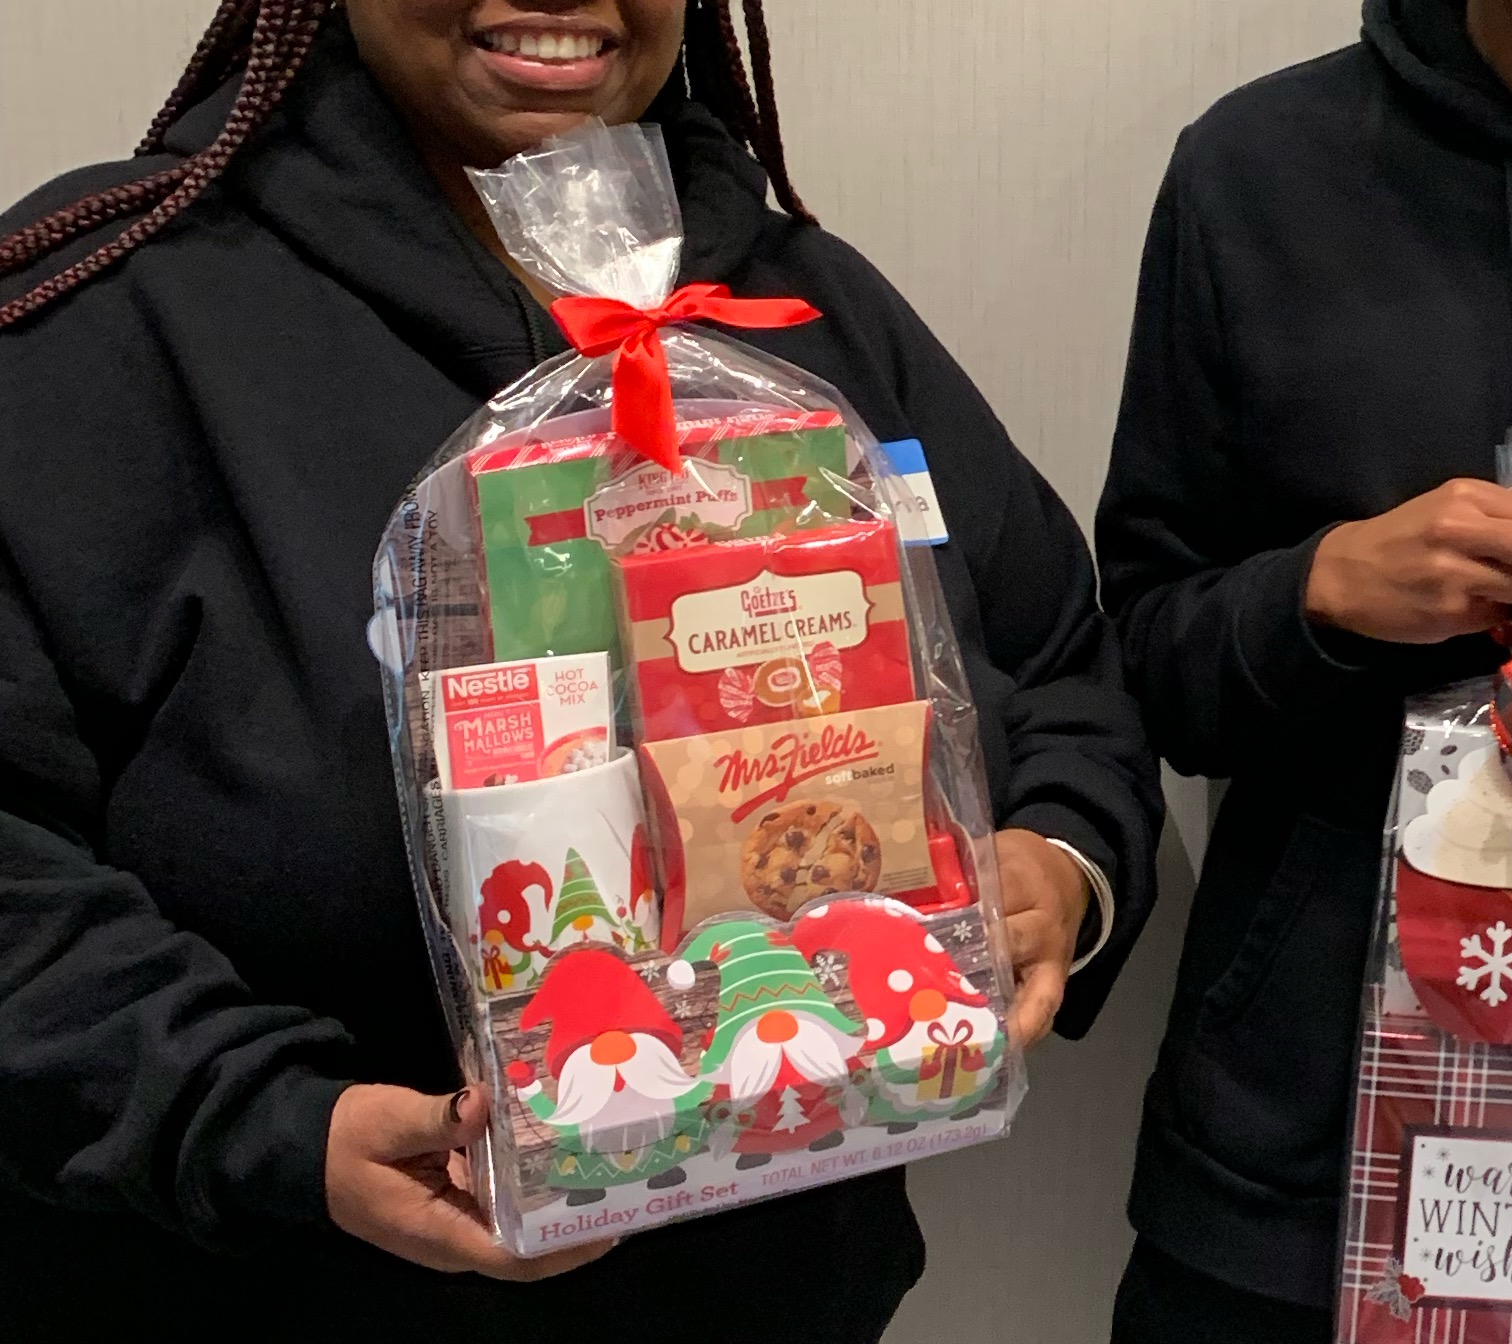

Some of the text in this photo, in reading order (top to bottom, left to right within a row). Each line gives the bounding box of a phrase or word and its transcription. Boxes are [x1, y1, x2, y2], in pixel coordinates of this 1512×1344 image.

[594, 493, 692, 522] Peppermint
[696, 489, 737, 504] Puffs
[688, 621, 780, 654] CARAMEL
[785, 611, 852, 639] CREAMS
[546, 680, 598, 697] COCOA
[554, 668, 584, 681] HOT
[560, 693, 586, 707] MIX
[453, 712, 532, 739] MARSH
[464, 727, 534, 754] MALLOWS
[713, 724, 876, 798] Mrs. Fields
[761, 1166, 804, 1186] TOTAL
[810, 1158, 839, 1175] NET
[906, 1136, 926, 1152] OZ
[539, 1181, 739, 1242] Holiday Gift Set
